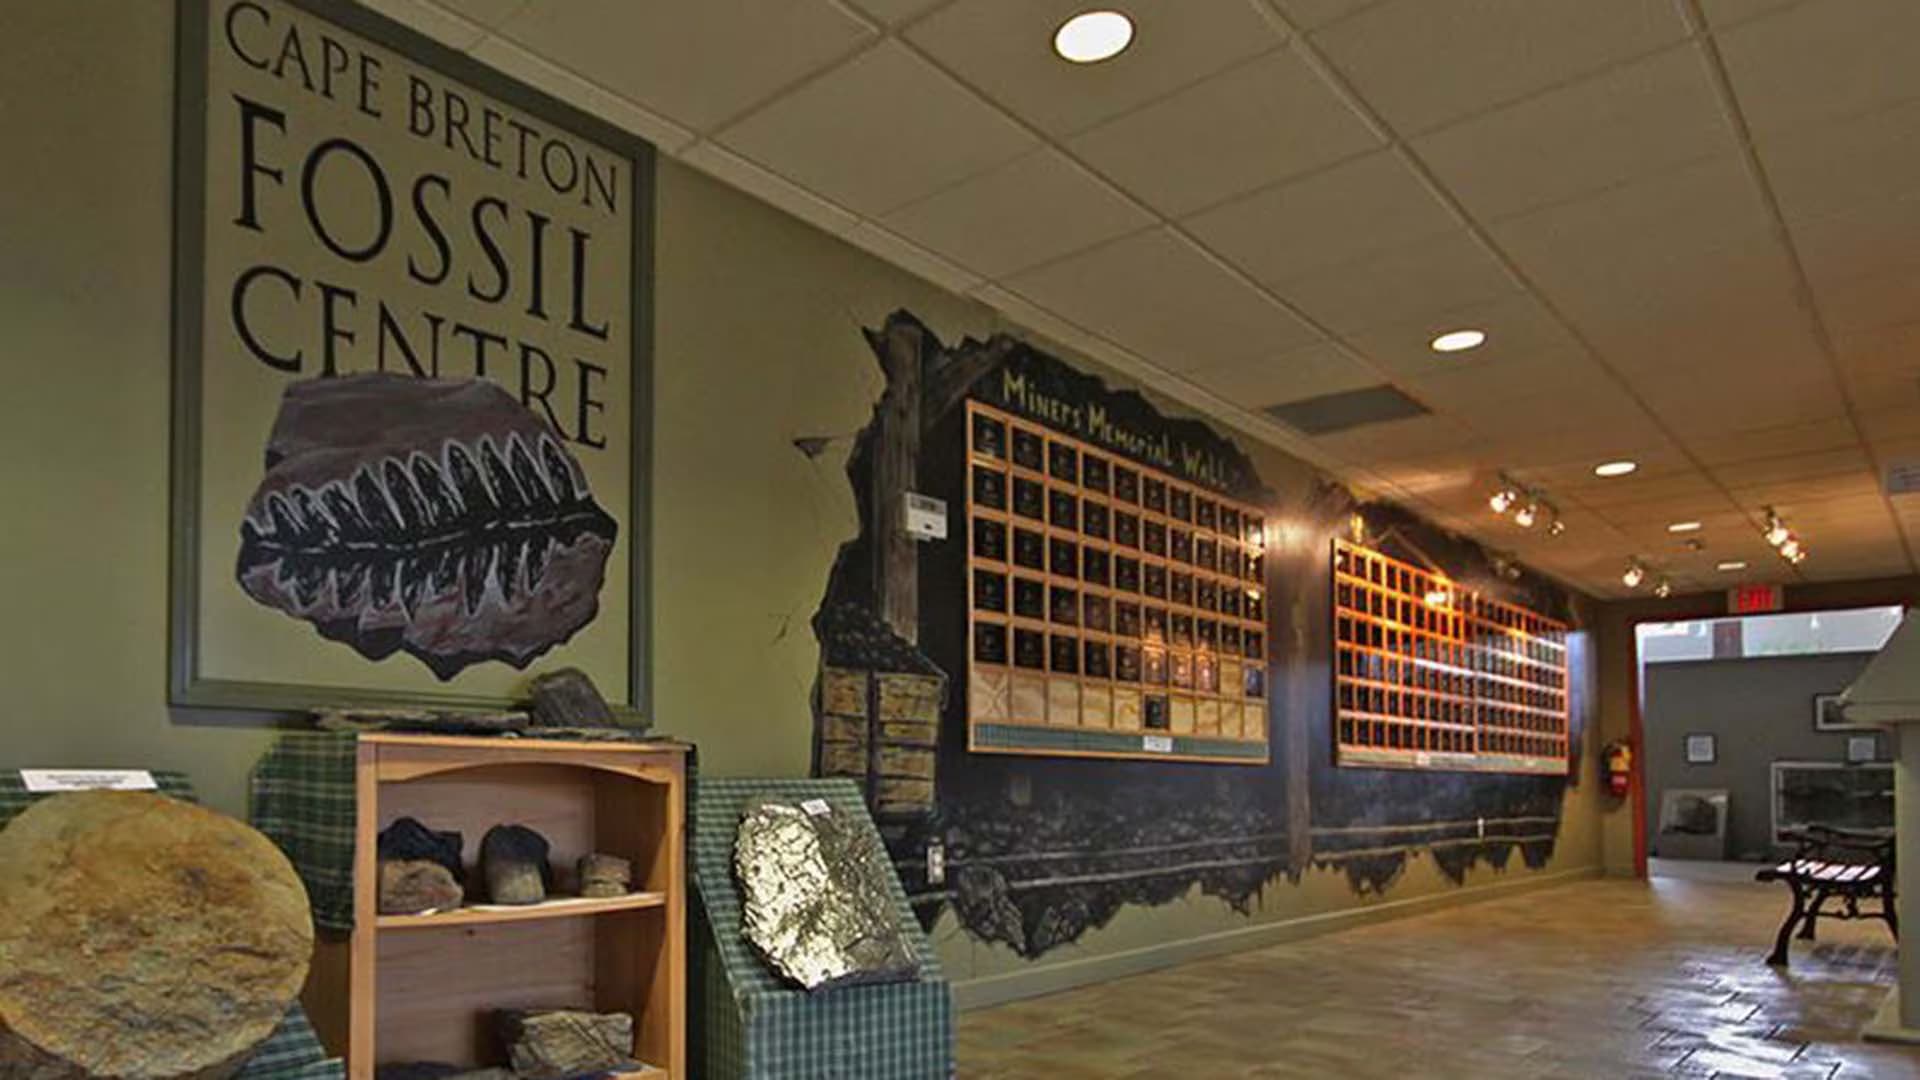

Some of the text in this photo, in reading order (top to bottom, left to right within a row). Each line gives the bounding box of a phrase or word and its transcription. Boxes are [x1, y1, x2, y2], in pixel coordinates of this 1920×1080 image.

[225, 1, 617, 214] CAPE BRETON
[231, 94, 609, 340] FOSSIL
[231, 265, 607, 450] CENTRE
